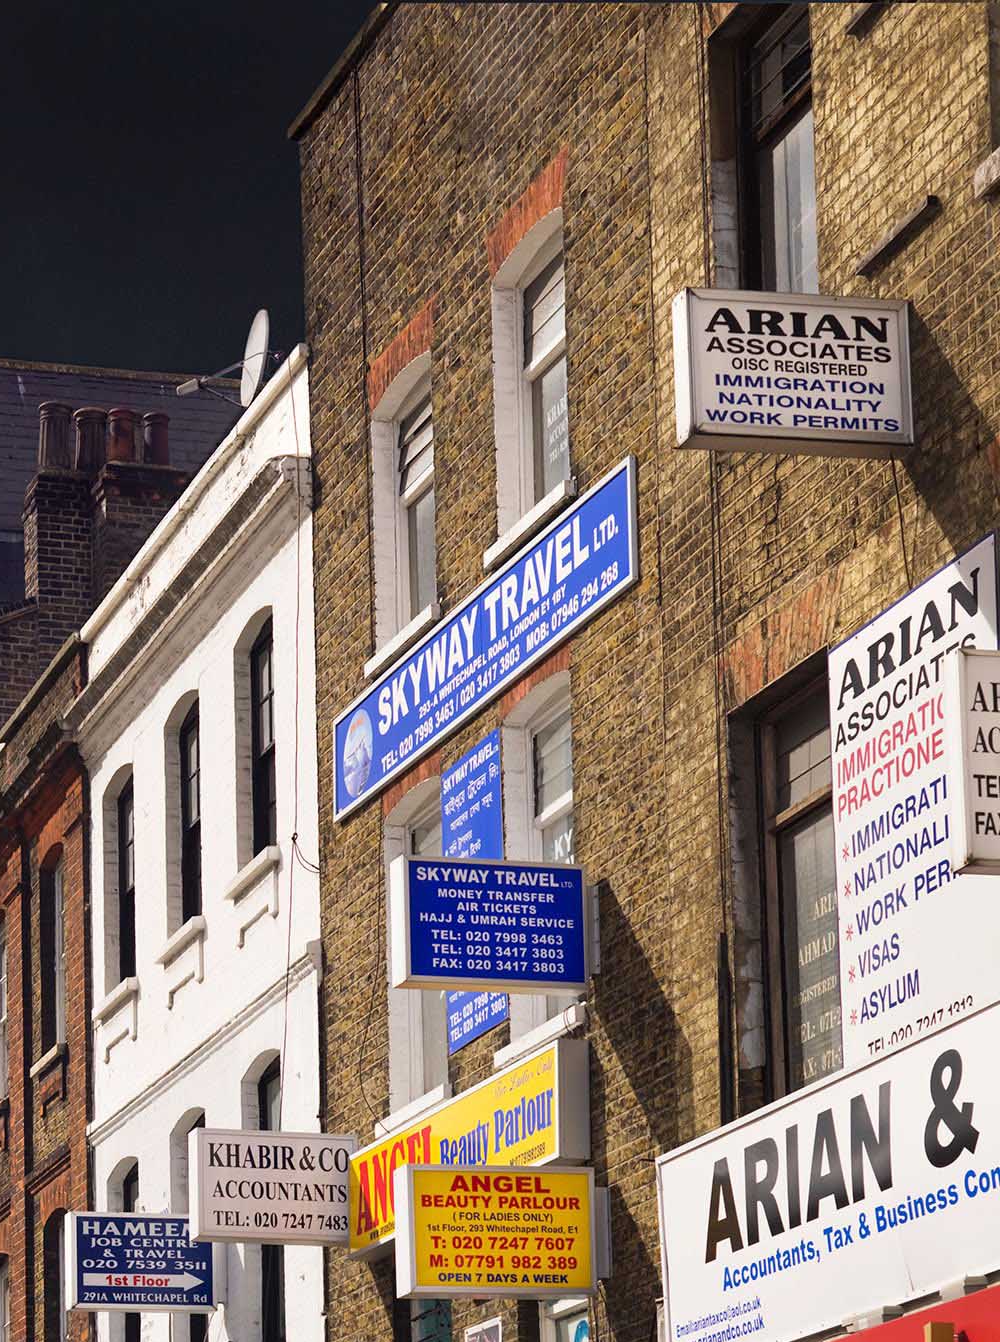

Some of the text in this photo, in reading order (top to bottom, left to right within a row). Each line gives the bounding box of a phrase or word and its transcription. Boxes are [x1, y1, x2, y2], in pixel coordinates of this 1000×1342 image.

[705, 307, 889, 343] ARIAN
[706, 337, 891, 363] ASSOCIATES
[732, 357, 867, 376] OISC REGISTERED
[715, 374, 884, 395] IMMIGRATION
[719, 391, 881, 412] NATIONALITY
[706, 409, 899, 432] WORK PERMITS
[378, 513, 619, 736] SKYWAY TRAVEL LTD.
[837, 567, 980, 711] ARIAN
[381, 562, 619, 773] TEL: 020 7998 3463 020 3417 3803 MOB: 07946 294 268
[438, 653, 487, 705] WHITECHAPEL
[487, 637, 509, 661] ROAD,
[509, 614, 541, 643] LONDON
[416, 867, 559, 888] SKYWAY TRAVEL
[438, 888, 555, 903] MONEY TRANSFER
[457, 903, 537, 915] AIR TICKETS
[856, 883, 908, 935] WORK
[419, 913, 574, 929] HAJJ & UMRAH SERVICE
[431, 930, 563, 945] TEL: 020 7998 3463
[432, 944, 564, 959] TEL: 020 3417 3803
[858, 933, 900, 978] VISAS
[432, 957, 565, 974] FAX: 020 3417 3803
[860, 969, 920, 1024] ASYLUM
[440, 1088, 553, 1167] Beauty Parlour
[208, 1142, 350, 1173] KHABIR & CO
[704, 1049, 980, 1264] ARIAN &
[212, 1180, 348, 1204] ACCOUNTANTS
[450, 1176, 550, 1194] ANGEL
[421, 1195, 580, 1210] BEAUTY PARLOUR
[213, 1210, 250, 1227] TEL:
[254, 1212, 278, 1229] 020
[281, 1213, 313, 1230] 7247
[317, 1214, 349, 1231] 7483
[483, 1212, 553, 1224] LADIES ONLY)
[427, 1224, 578, 1235] 1st Floor, 293 Whitechapel Road, E1
[722, 1183, 958, 1291] Accountants, Tax & Business
[90, 1238, 199, 1249] JOB CENTRE
[430, 1236, 575, 1251] T: 020 7247 7607
[82, 1259, 118, 1269] 020
[126, 1260, 167, 1270] 7539
[103, 1249, 185, 1260] & TRAVEL
[429, 1255, 578, 1270] M: 07791 982 389
[105, 1274, 170, 1287] 1st Floor
[438, 1273, 569, 1284] OPEN 7 DAYS A WEEK
[83, 1291, 207, 1303] 291A WHITECHAPEL Rd
